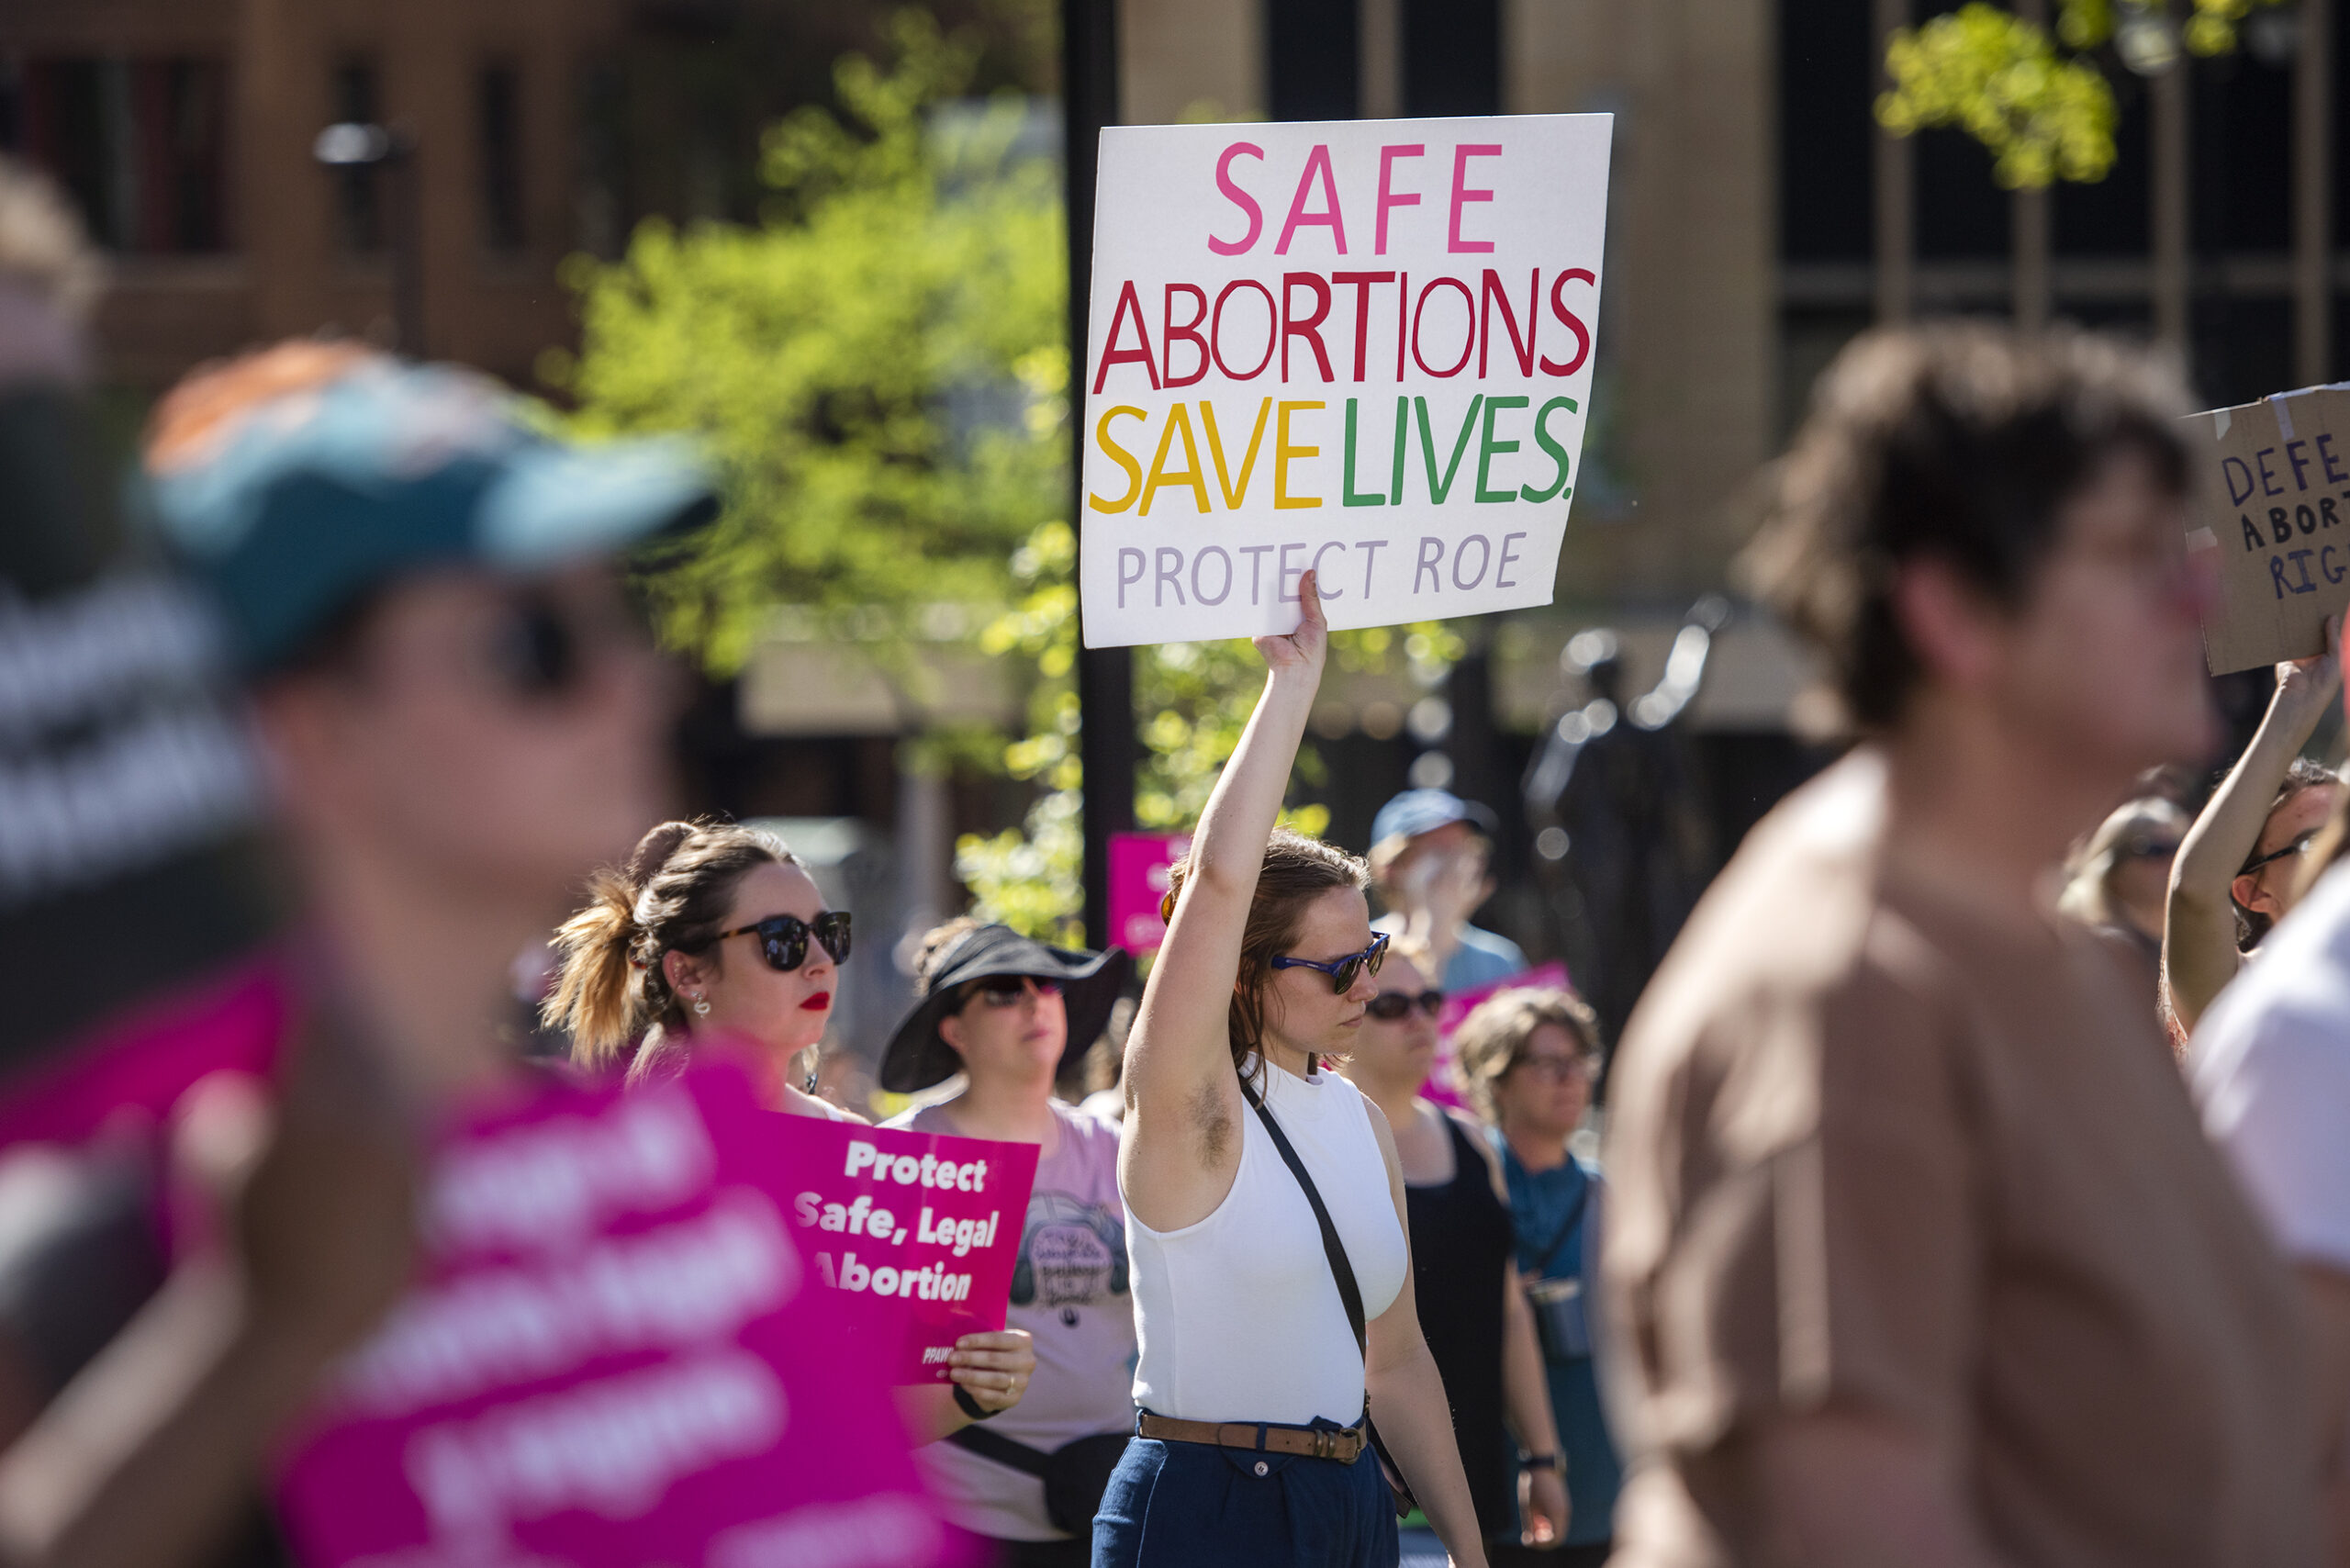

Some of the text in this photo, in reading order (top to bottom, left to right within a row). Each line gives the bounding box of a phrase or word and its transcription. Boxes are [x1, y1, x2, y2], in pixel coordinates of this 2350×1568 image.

[1207, 141, 1503, 257] SAFE
[1092, 267, 1596, 395] ABORTIONS
[1089, 394, 1578, 517] SAVE LIVES.
[2241, 490, 2350, 552] ABOR
[1117, 531, 1528, 610] PROTECT ROE
[2270, 543, 2350, 599] RIG
[845, 1140, 987, 1193] Protect
[793, 1191, 908, 1247] Safe,
[916, 1206, 1000, 1257] Legal
[922, 1346, 955, 1365] PPAW
